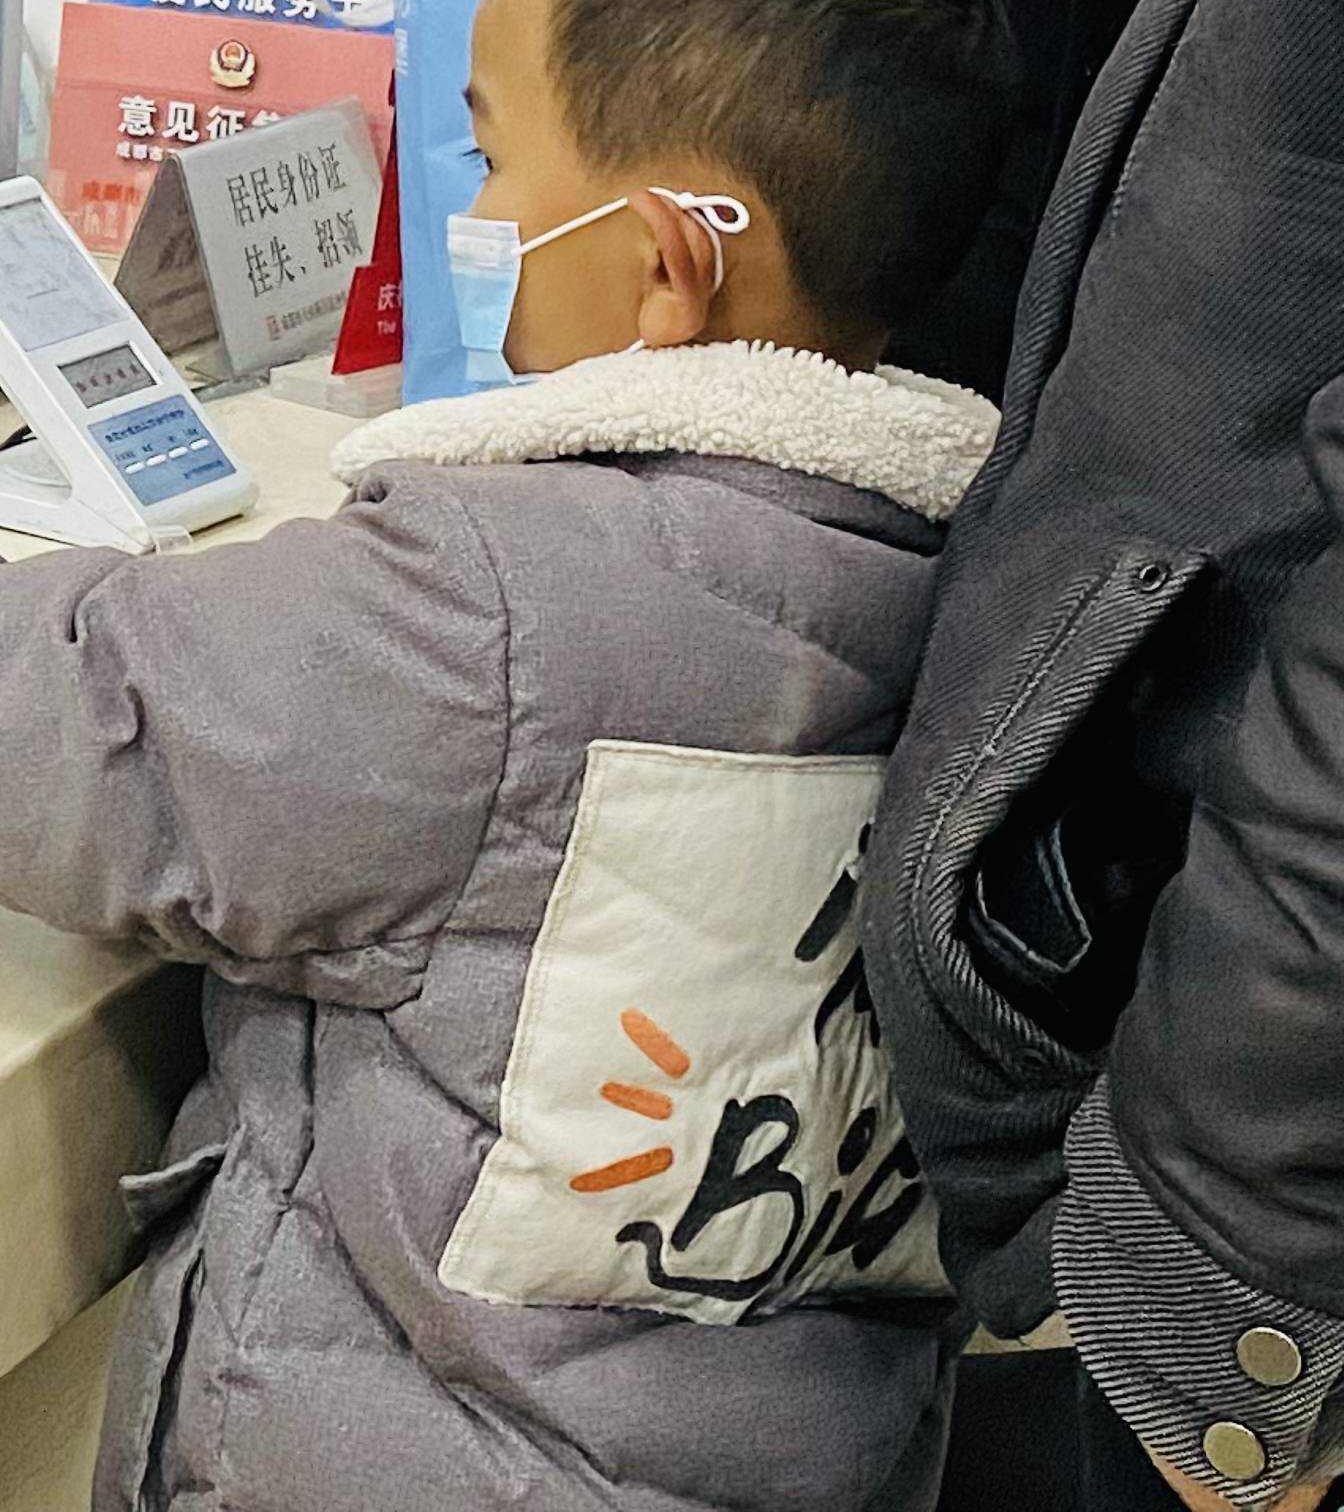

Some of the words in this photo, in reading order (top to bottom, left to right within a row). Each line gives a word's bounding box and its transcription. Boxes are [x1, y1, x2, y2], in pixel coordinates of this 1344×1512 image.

[227, 141, 346, 227] 居民身份证
